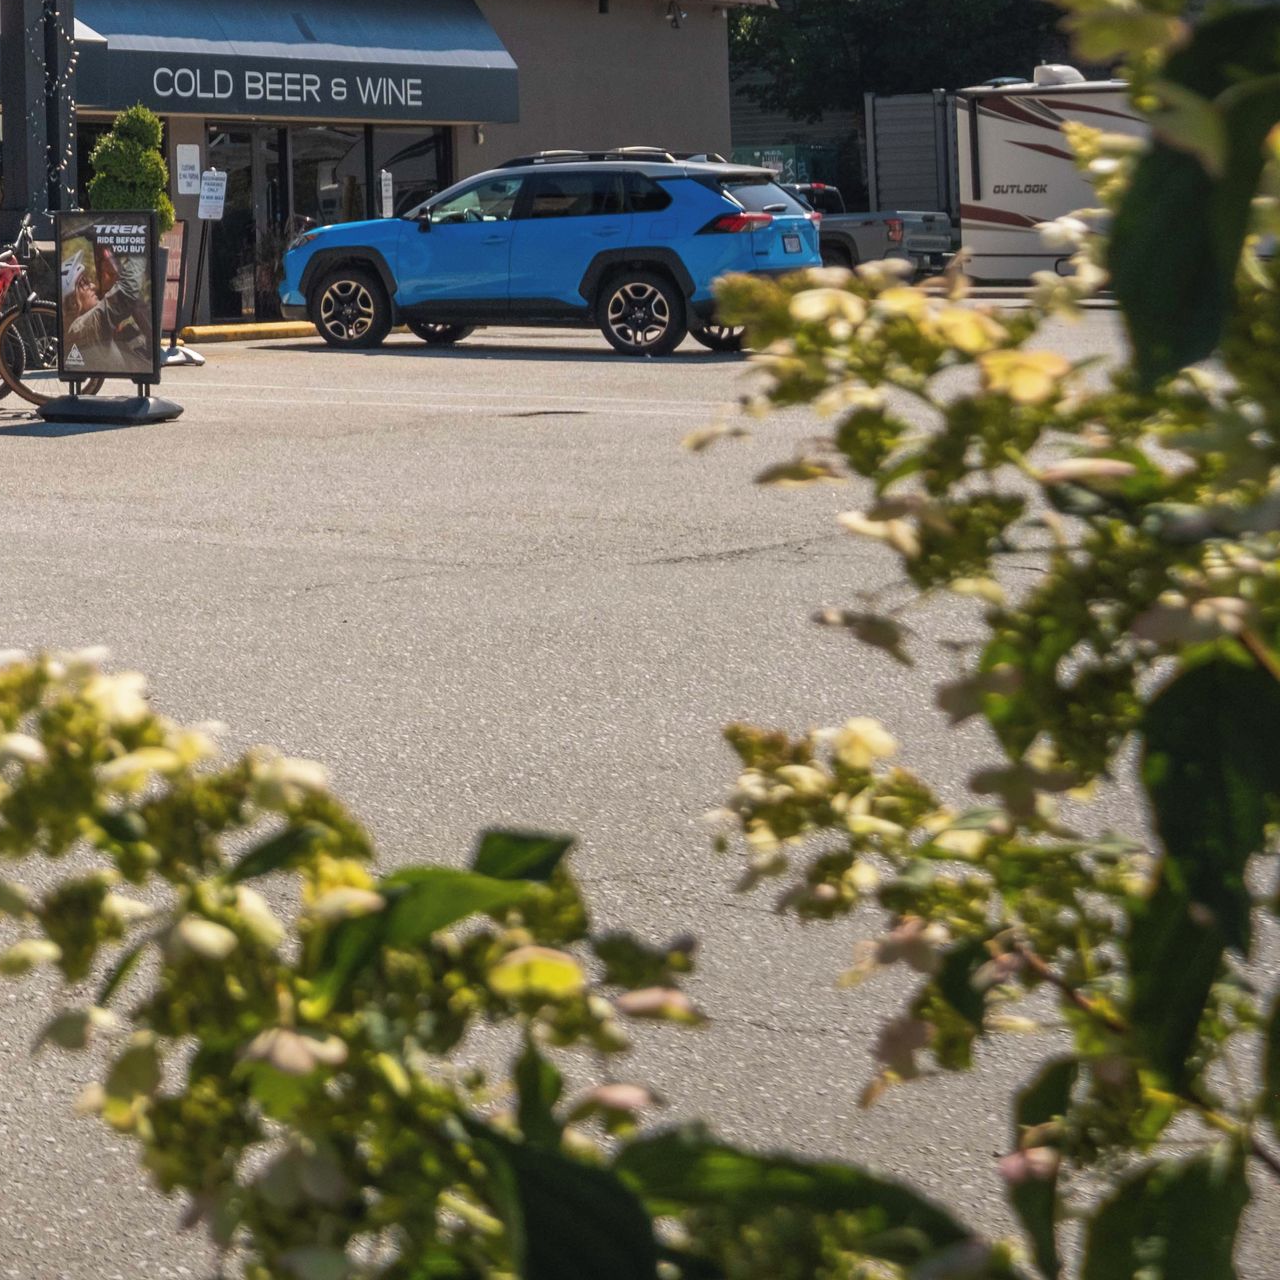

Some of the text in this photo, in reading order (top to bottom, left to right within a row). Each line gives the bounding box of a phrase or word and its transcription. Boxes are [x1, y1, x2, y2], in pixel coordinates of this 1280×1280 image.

[153, 67, 422, 106] COLD BEER & WINE
[993, 184, 1048, 194] OUTLOOK
[93, 224, 147, 234] TREK
[96, 236, 146, 244] RIDE BEFORE
[112, 245, 146, 253] YOU BUY
